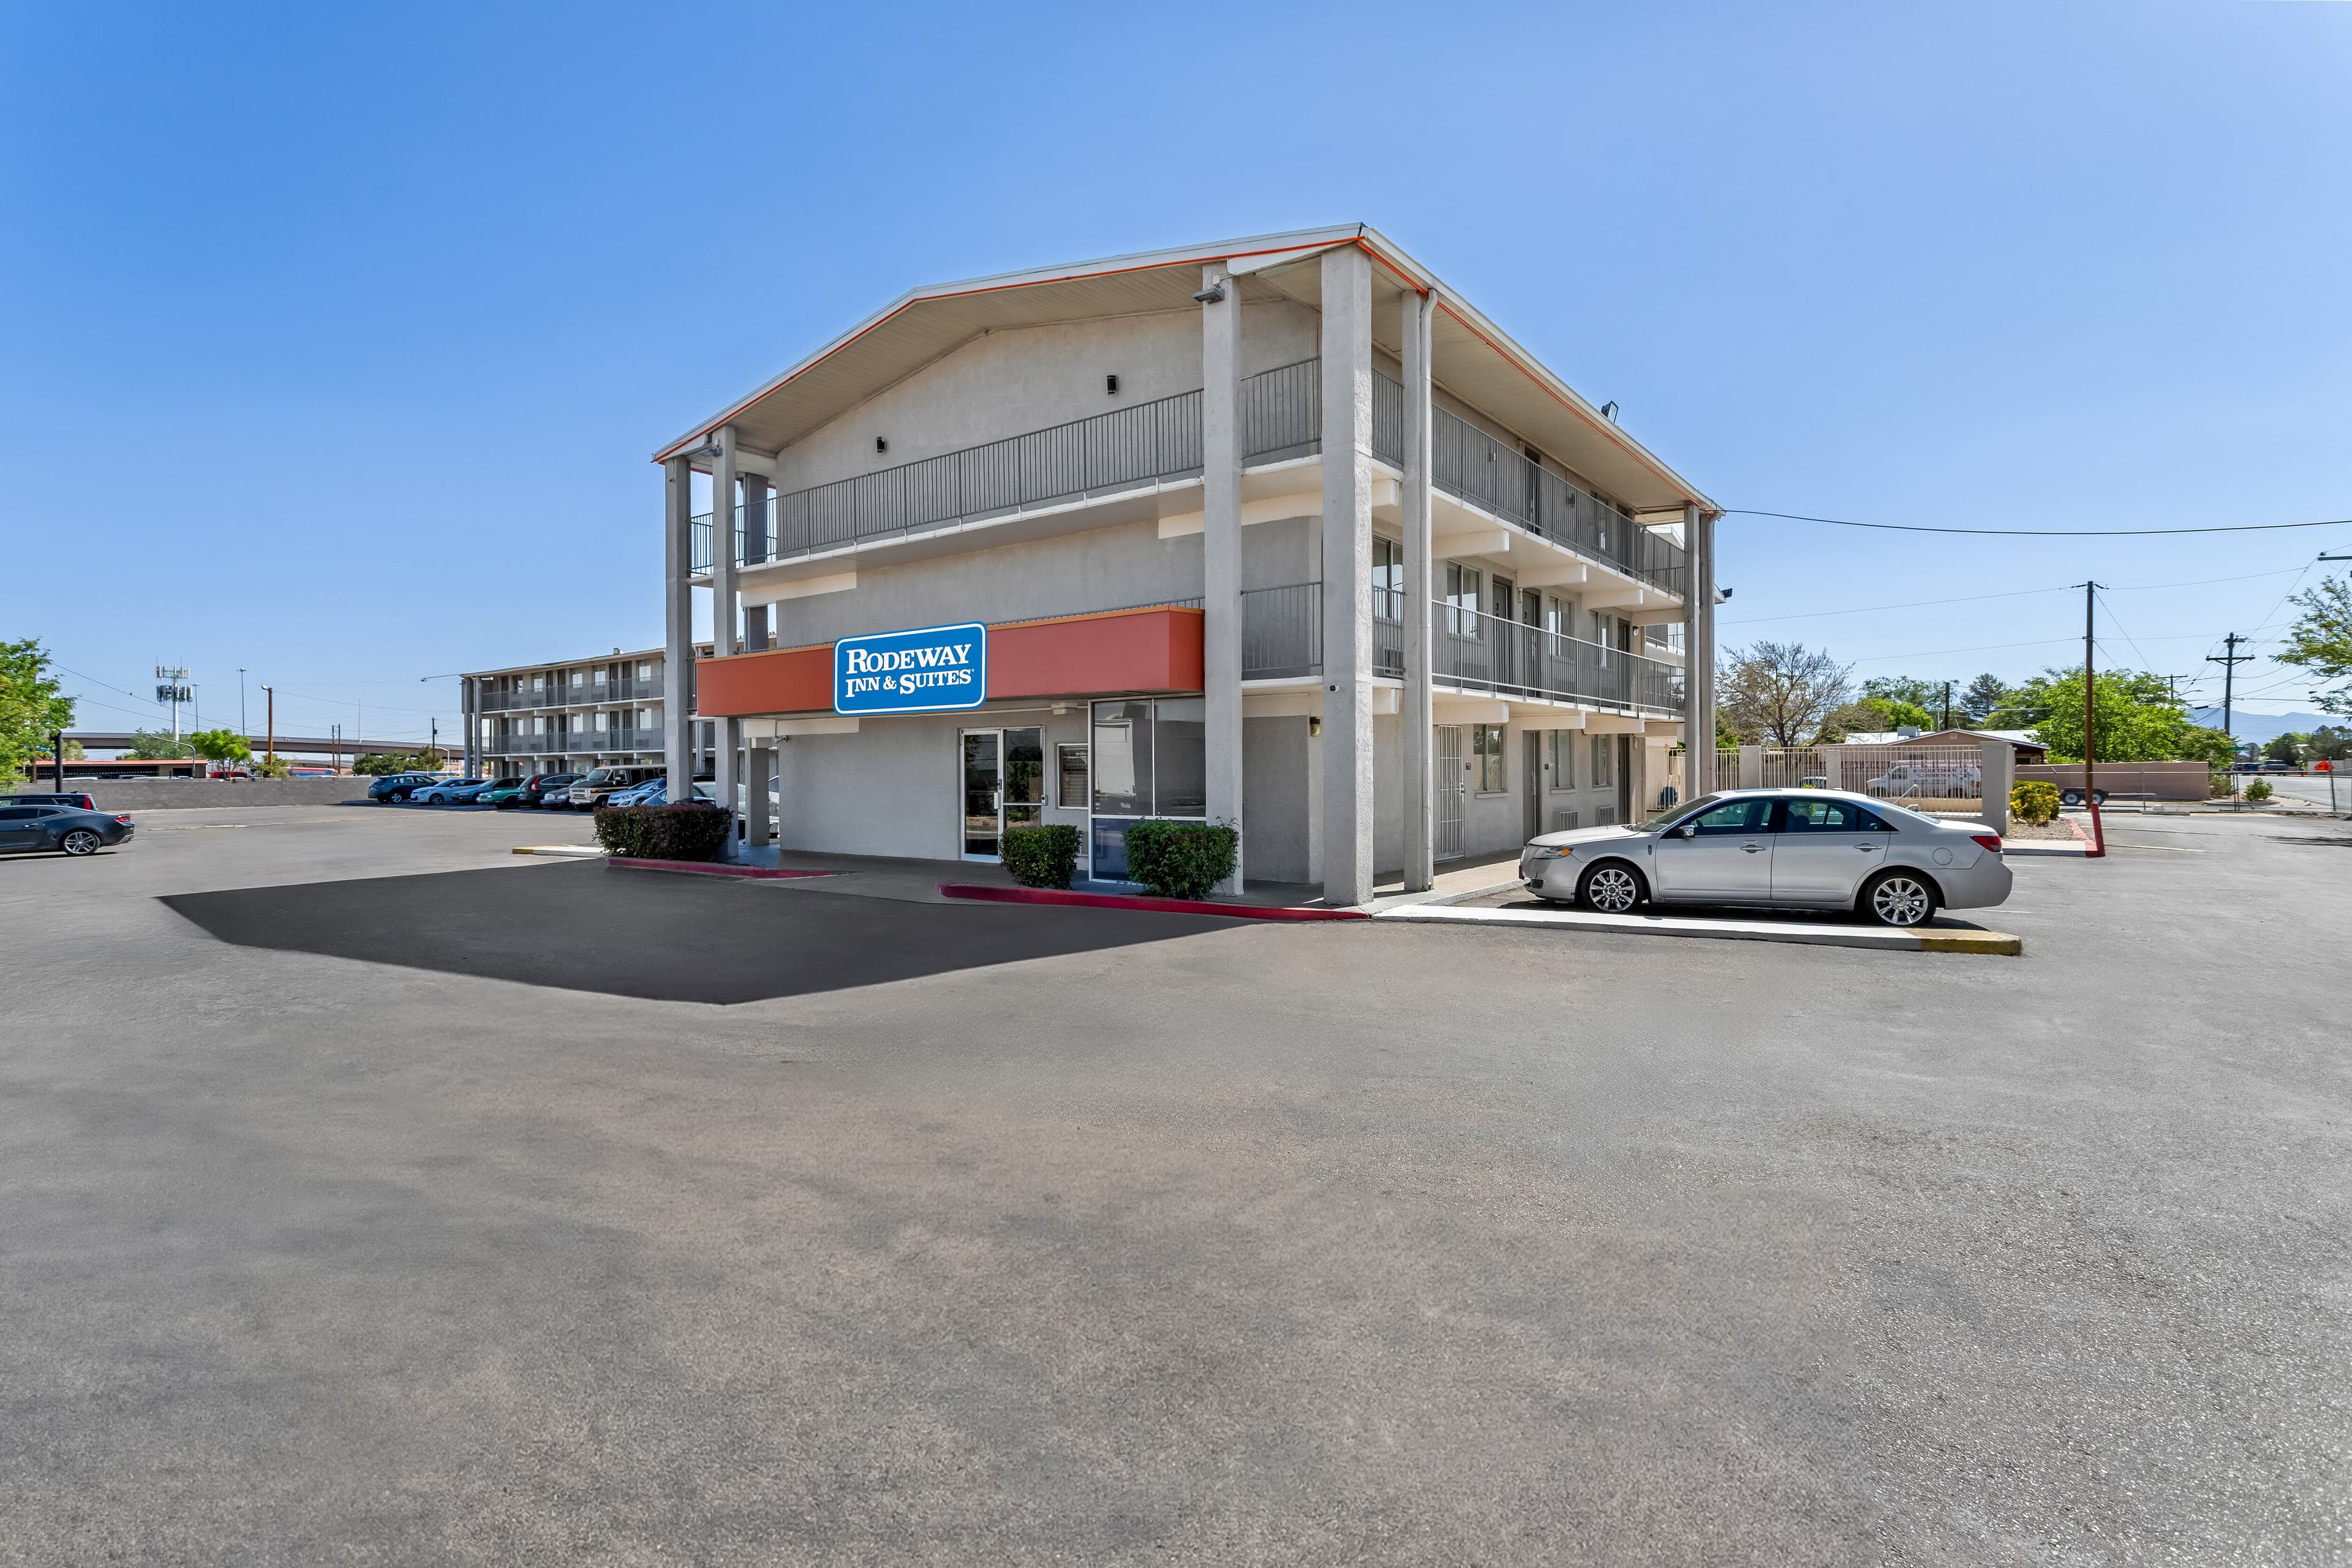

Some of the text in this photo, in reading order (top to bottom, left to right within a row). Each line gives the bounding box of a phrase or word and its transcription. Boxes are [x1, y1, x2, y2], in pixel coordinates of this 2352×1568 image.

[846, 644, 971, 674] RODEWAY
[845, 669, 972, 698] INN & SUITES
